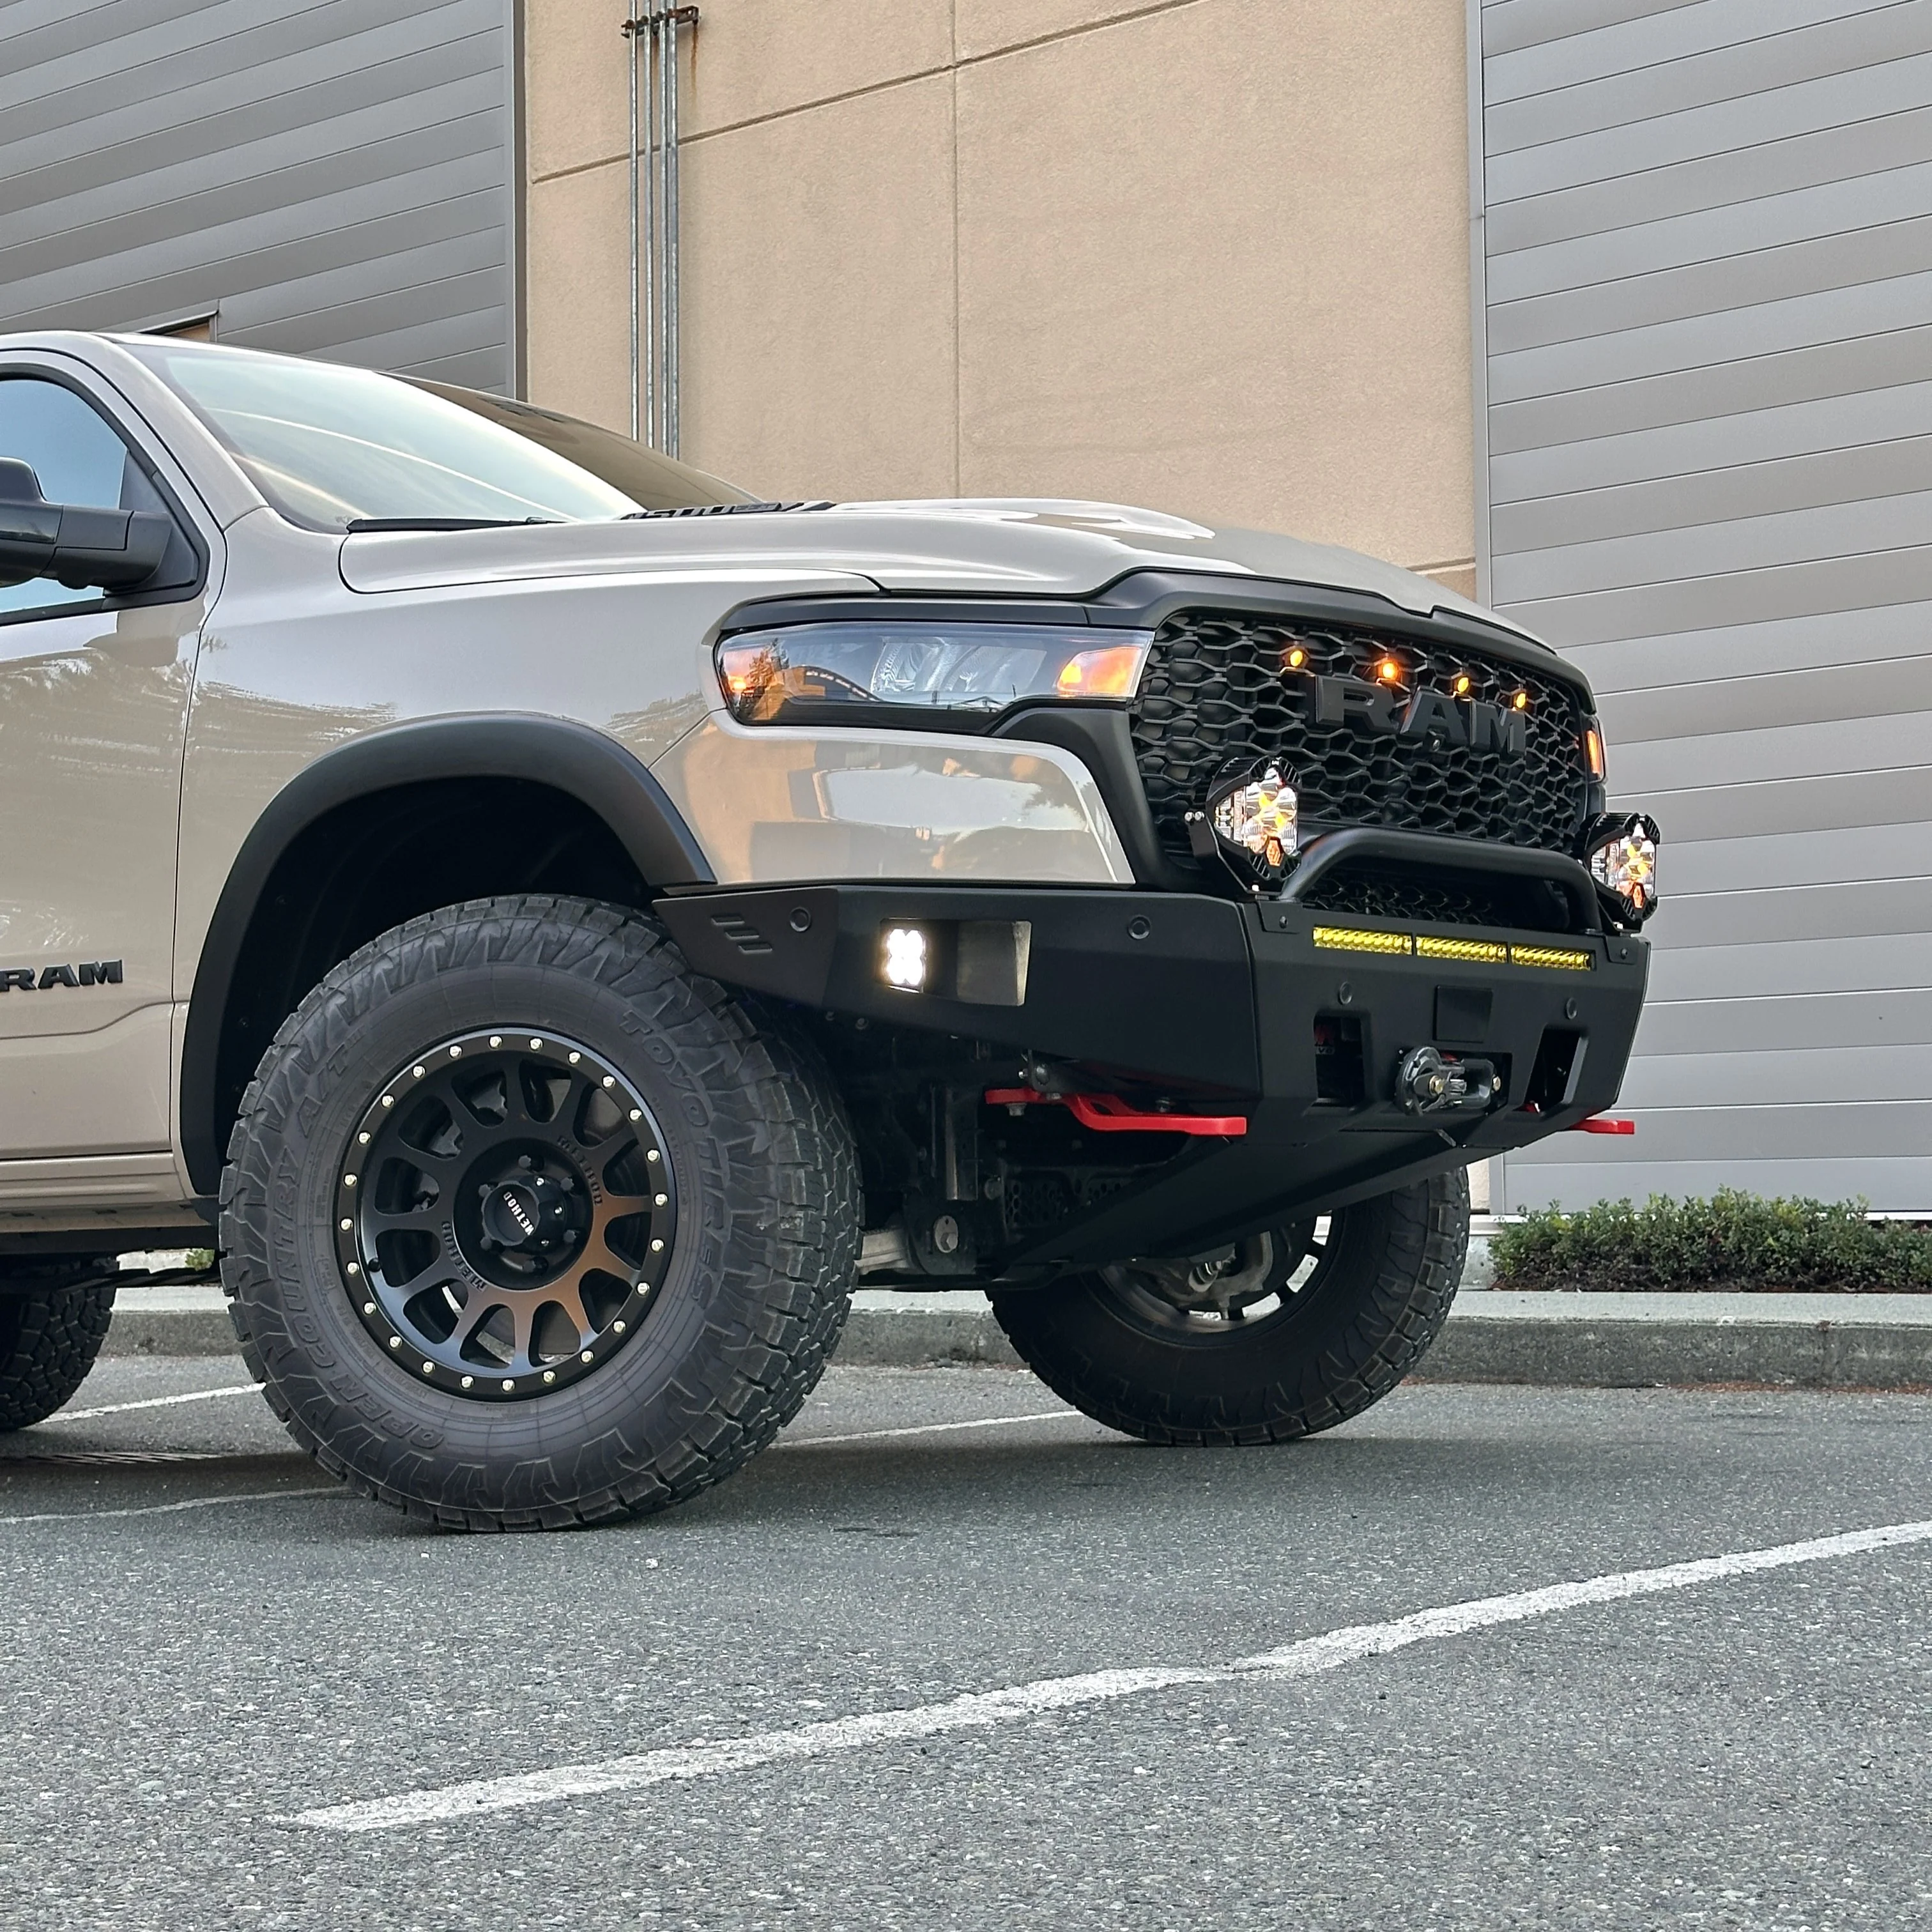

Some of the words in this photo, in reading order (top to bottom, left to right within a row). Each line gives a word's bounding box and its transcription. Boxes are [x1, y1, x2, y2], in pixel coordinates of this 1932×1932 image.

[1315, 675, 1527, 757] RAM
[0, 959, 123, 992] RAM
[619, 1009, 709, 1127] TOYO
[503, 1191, 535, 1236] METHOD
[273, 1145, 336, 1368] COUNTRY
[441, 1220, 487, 1292] METHOD
[329, 1374, 445, 1450] OPEN
